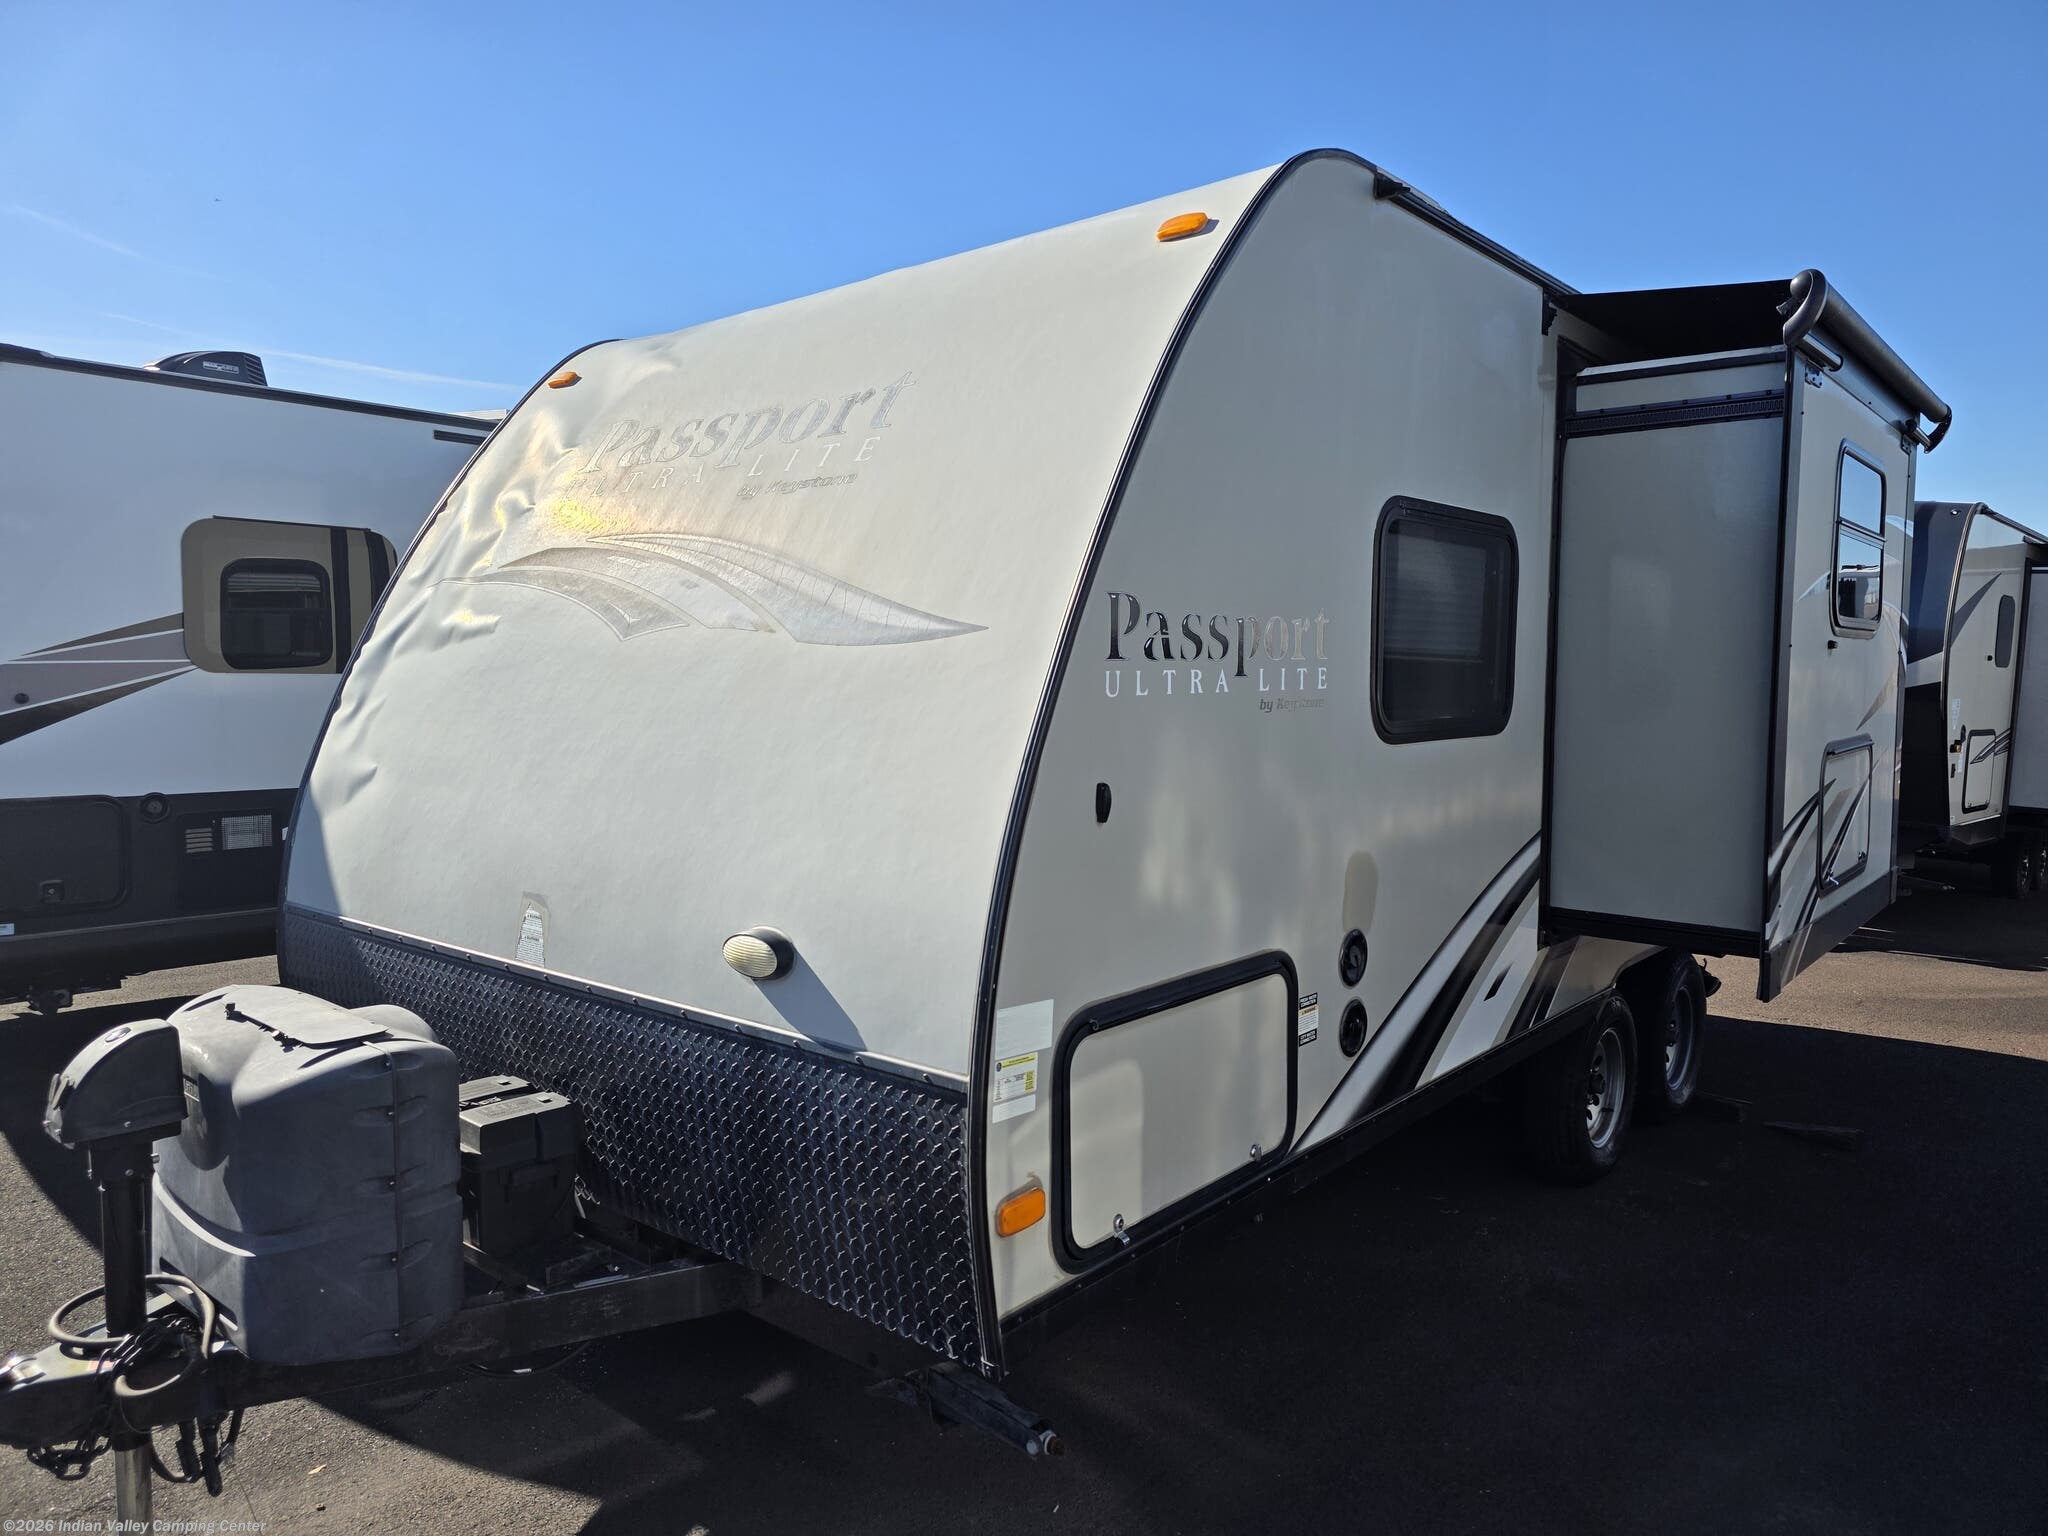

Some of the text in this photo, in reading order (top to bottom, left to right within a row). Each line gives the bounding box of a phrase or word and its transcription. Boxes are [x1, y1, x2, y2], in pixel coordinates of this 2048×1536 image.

[577, 368, 917, 473] Passport
[747, 436, 881, 477] LITE
[1105, 591, 1329, 677] Passport
[1105, 667, 1328, 697] ULTRA LITE
[1259, 699, 1273, 713] by
